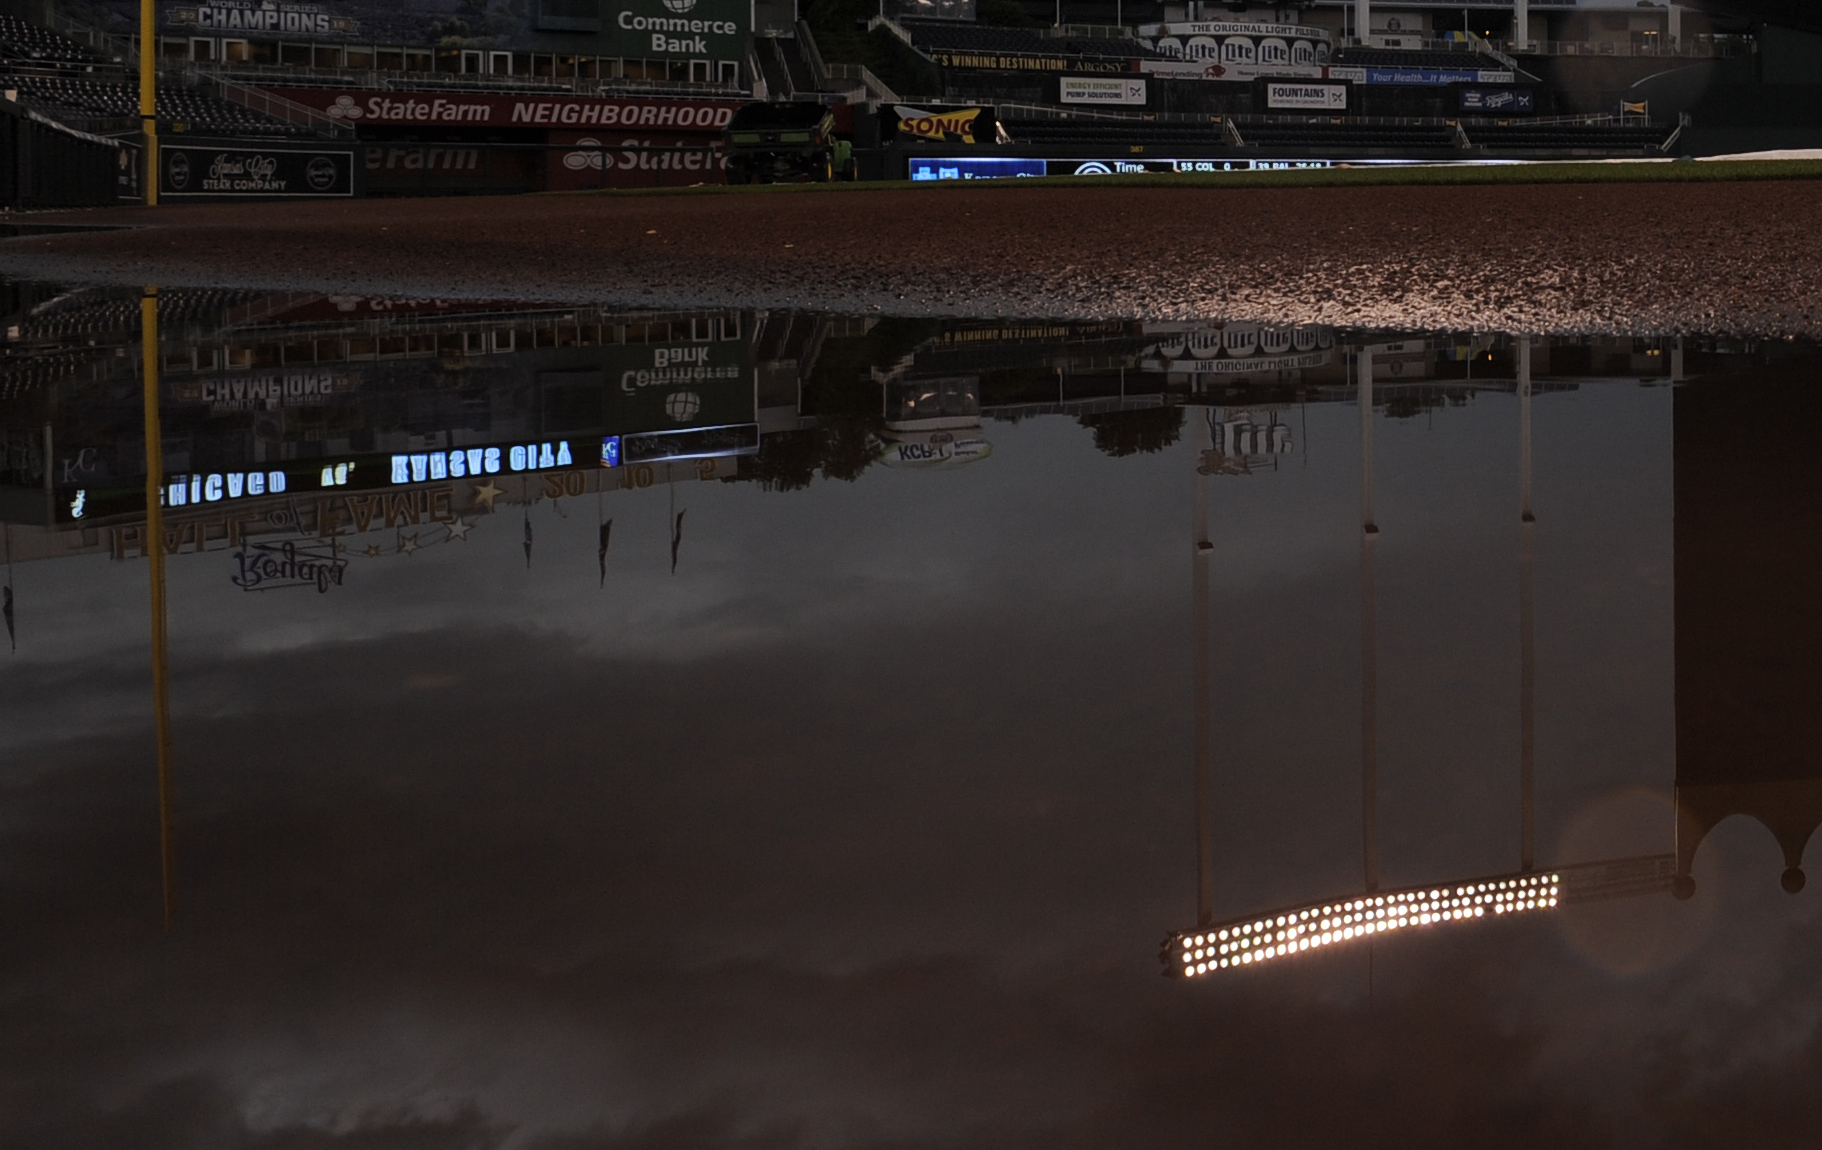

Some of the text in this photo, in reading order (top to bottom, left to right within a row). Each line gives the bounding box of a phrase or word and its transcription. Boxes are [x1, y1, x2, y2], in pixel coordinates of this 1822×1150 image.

[199, 7, 330, 34] CHAMPIONS
[618, 11, 737, 35] Commerce
[1191, 24, 1211, 33] THE
[1214, 24, 1263, 33] ORIGINAL
[1265, 26, 1294, 35] LIGHT
[651, 33, 708, 54] Bank
[952, 55, 998, 69] WINNING
[1000, 57, 1068, 71] DESTINATION!
[1074, 61, 1124, 72] ARGOSY
[1372, 72, 1394, 82] Your
[1066, 91, 1122, 99] PUMP SOLUTIONS
[1272, 87, 1325, 99] FOUNTAINS
[511, 101, 732, 127] NEIGHBORHOOD
[902, 117, 975, 136] SONIC
[1113, 161, 1146, 173] Time
[1180, 162, 1193, 172] 55
[1195, 162, 1215, 171] COL
[202, 179, 288, 192] STEAK COMPANY
